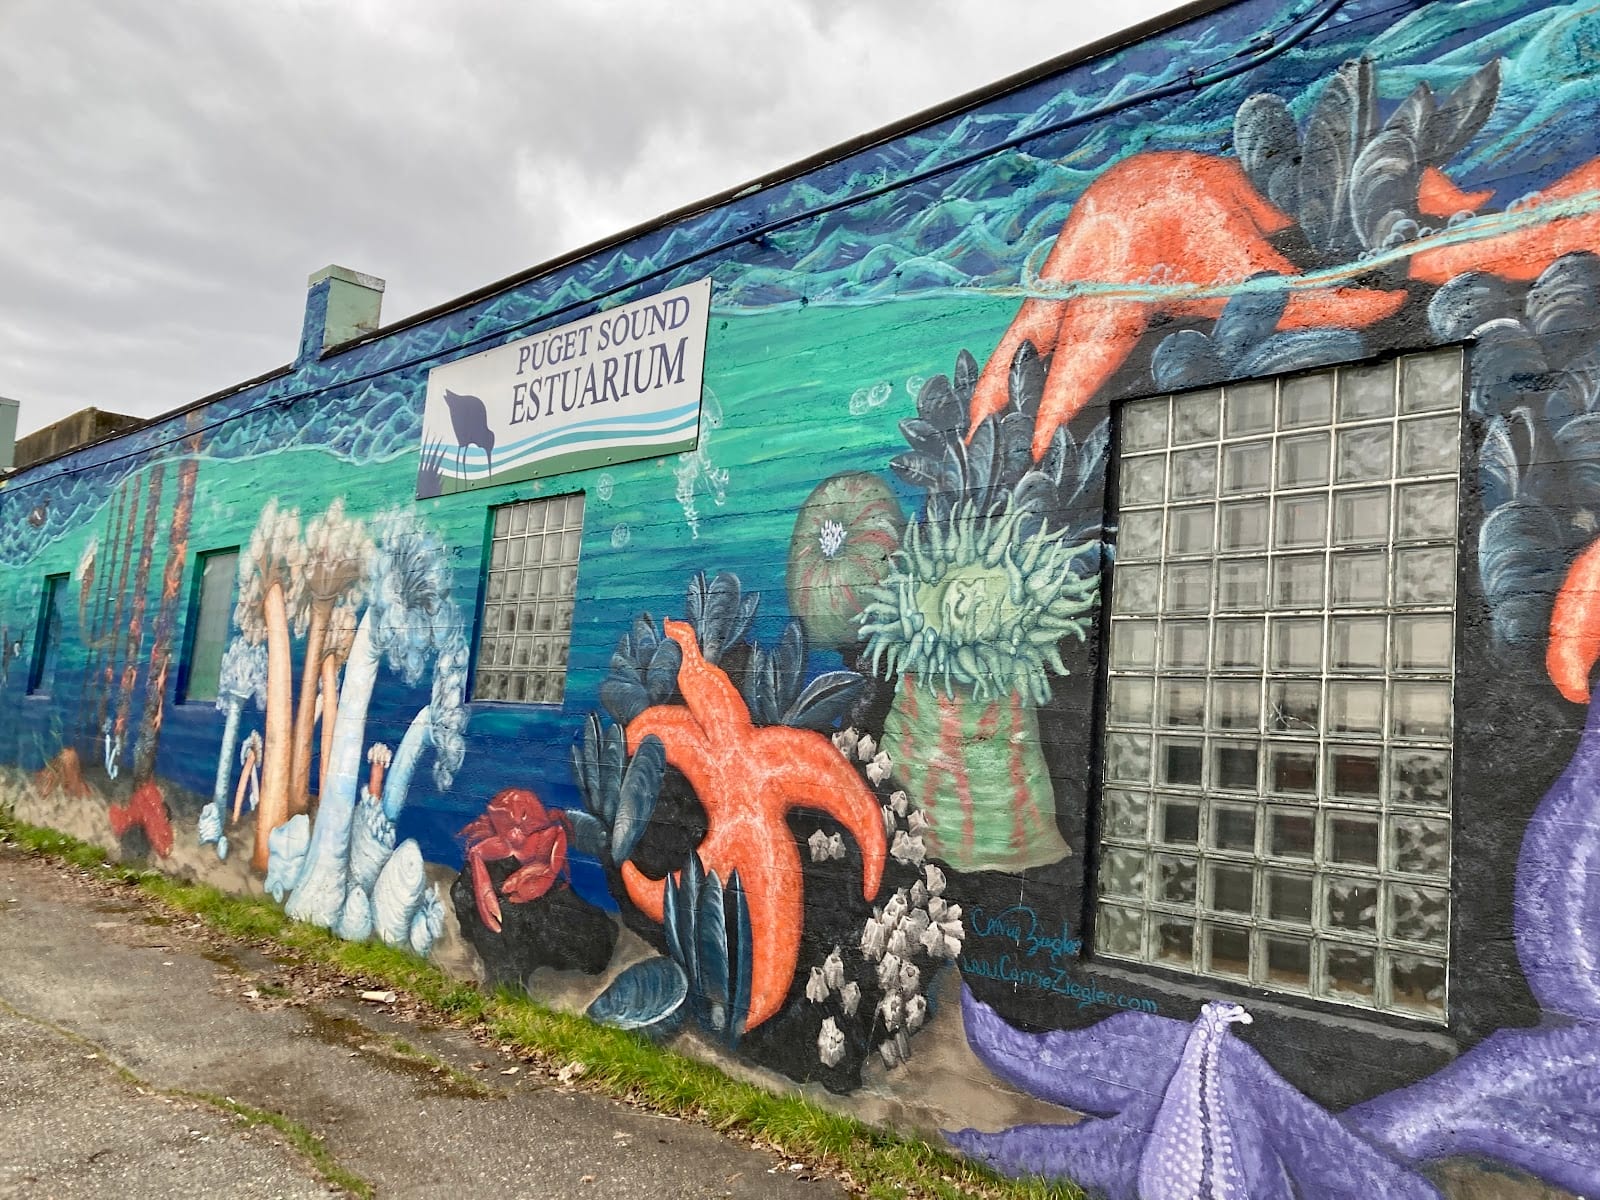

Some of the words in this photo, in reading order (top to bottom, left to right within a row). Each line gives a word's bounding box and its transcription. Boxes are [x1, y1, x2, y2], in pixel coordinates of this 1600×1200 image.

[517, 326, 592, 375] PUGET
[598, 296, 690, 351] SOUND
[510, 337, 688, 425] ESTUARIUM
